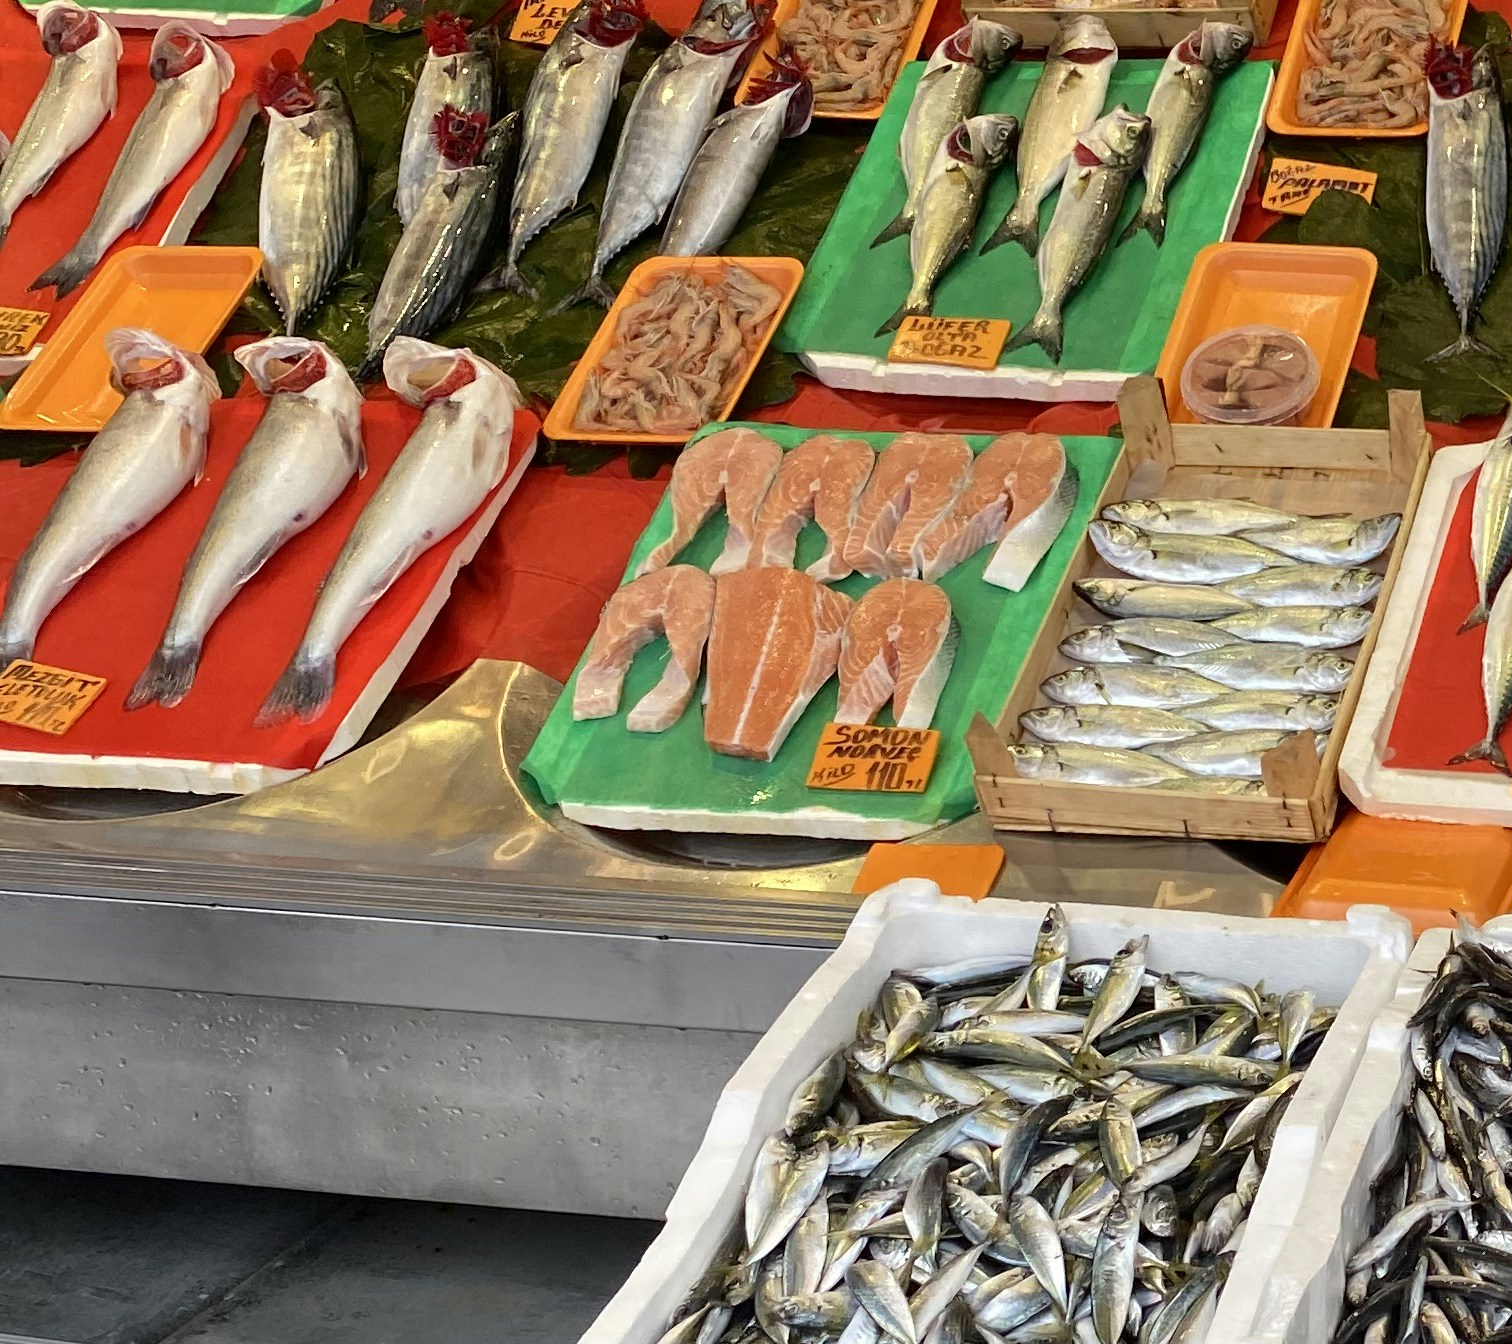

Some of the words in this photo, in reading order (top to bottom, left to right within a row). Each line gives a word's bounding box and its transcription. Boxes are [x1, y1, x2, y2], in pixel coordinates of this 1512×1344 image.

[908, 318, 992, 334] LÜFER
[823, 725, 932, 746] SOMON
[866, 760, 908, 791] 110
